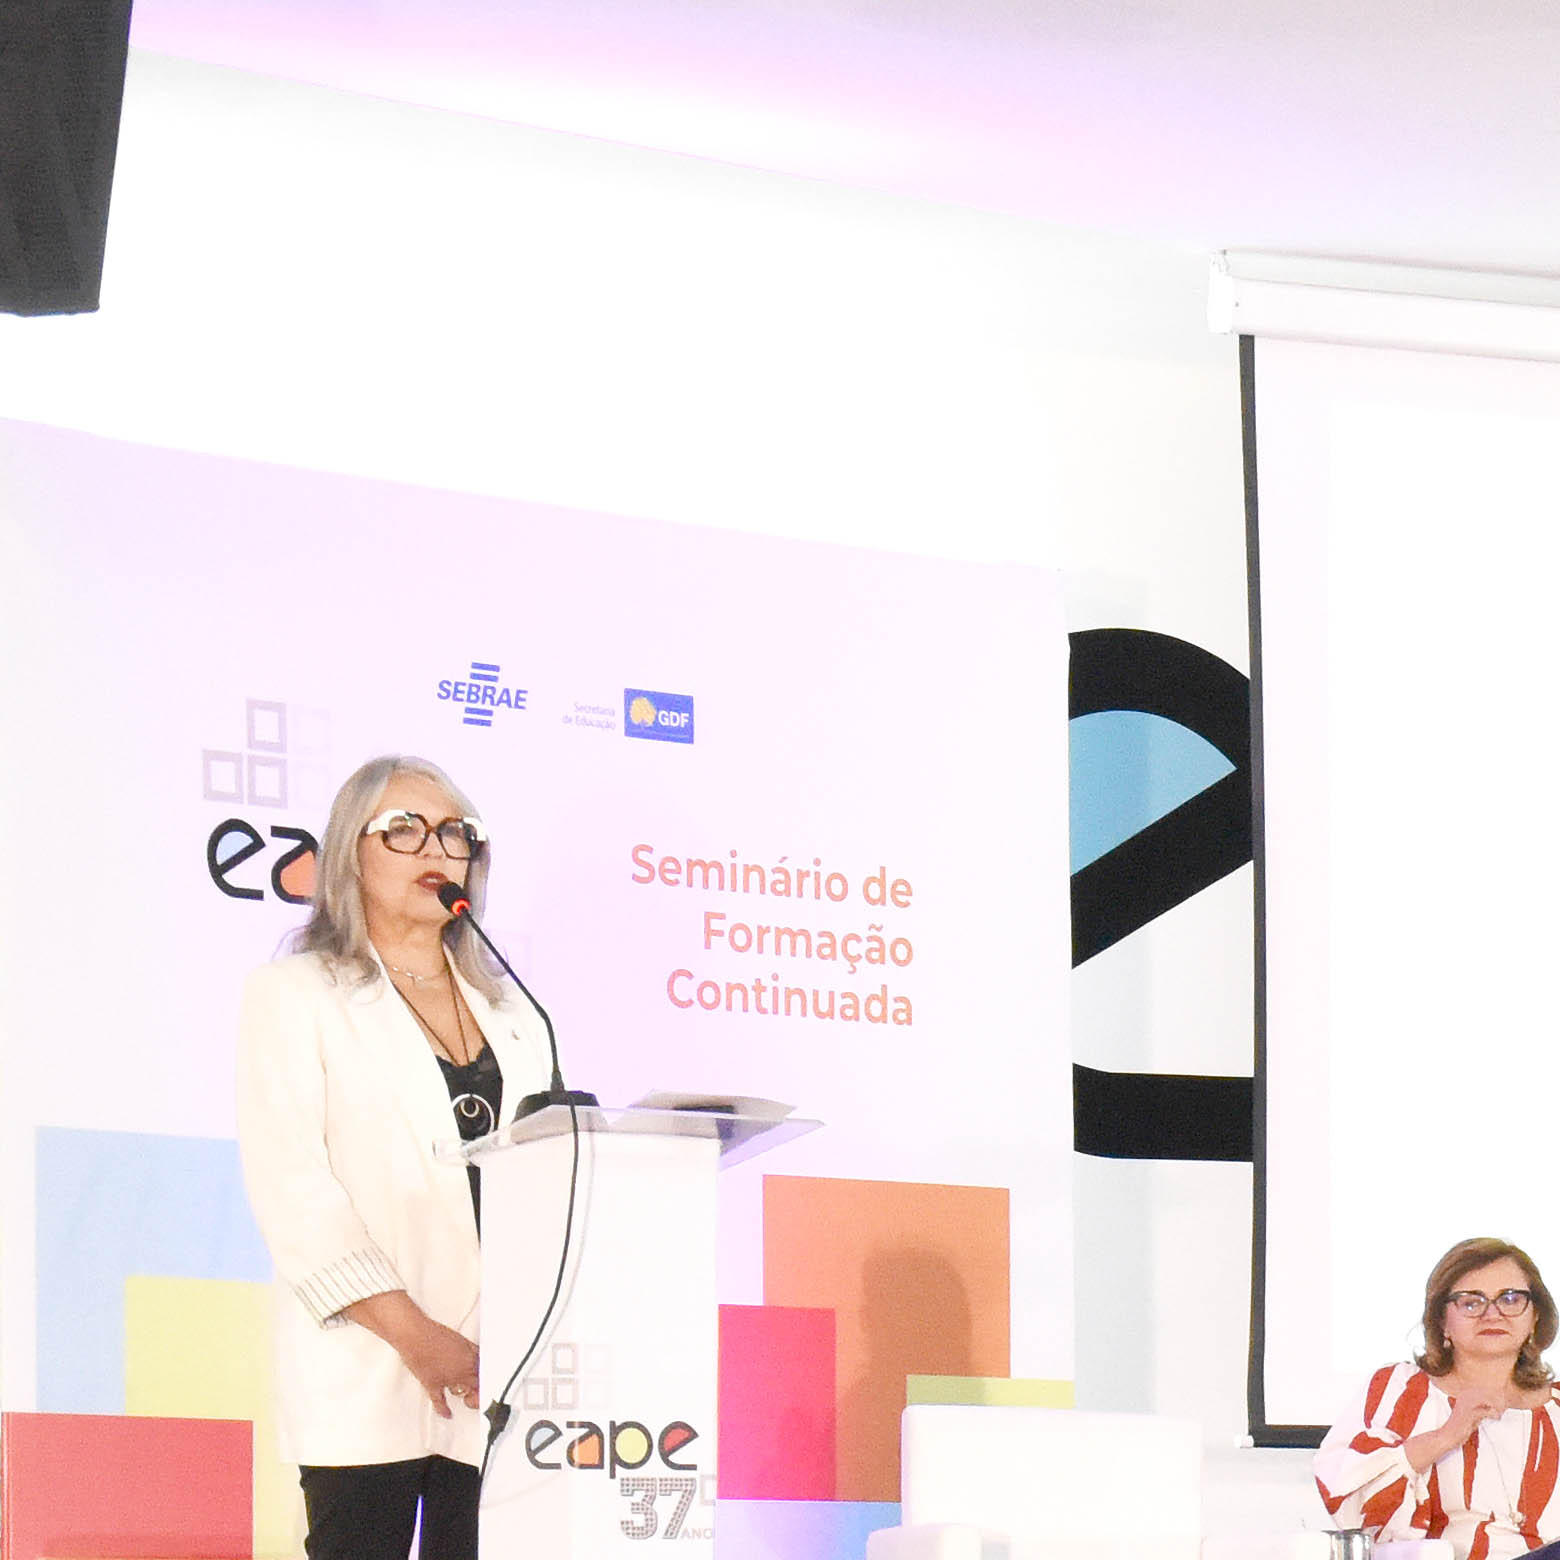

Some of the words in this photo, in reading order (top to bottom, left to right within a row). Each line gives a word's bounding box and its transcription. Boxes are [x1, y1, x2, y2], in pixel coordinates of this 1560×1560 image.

[437, 680, 528, 710] SEBRAE
[658, 710, 688, 728] GDF
[207, 818, 318, 905] ea
[631, 844, 849, 902] Seminário
[862, 866, 913, 908] de
[704, 911, 914, 974] Formação
[666, 968, 912, 1026] Continuada
[525, 1419, 699, 1479] eape
[620, 1477, 697, 1540] 37
[681, 1527, 713, 1540] ANO
